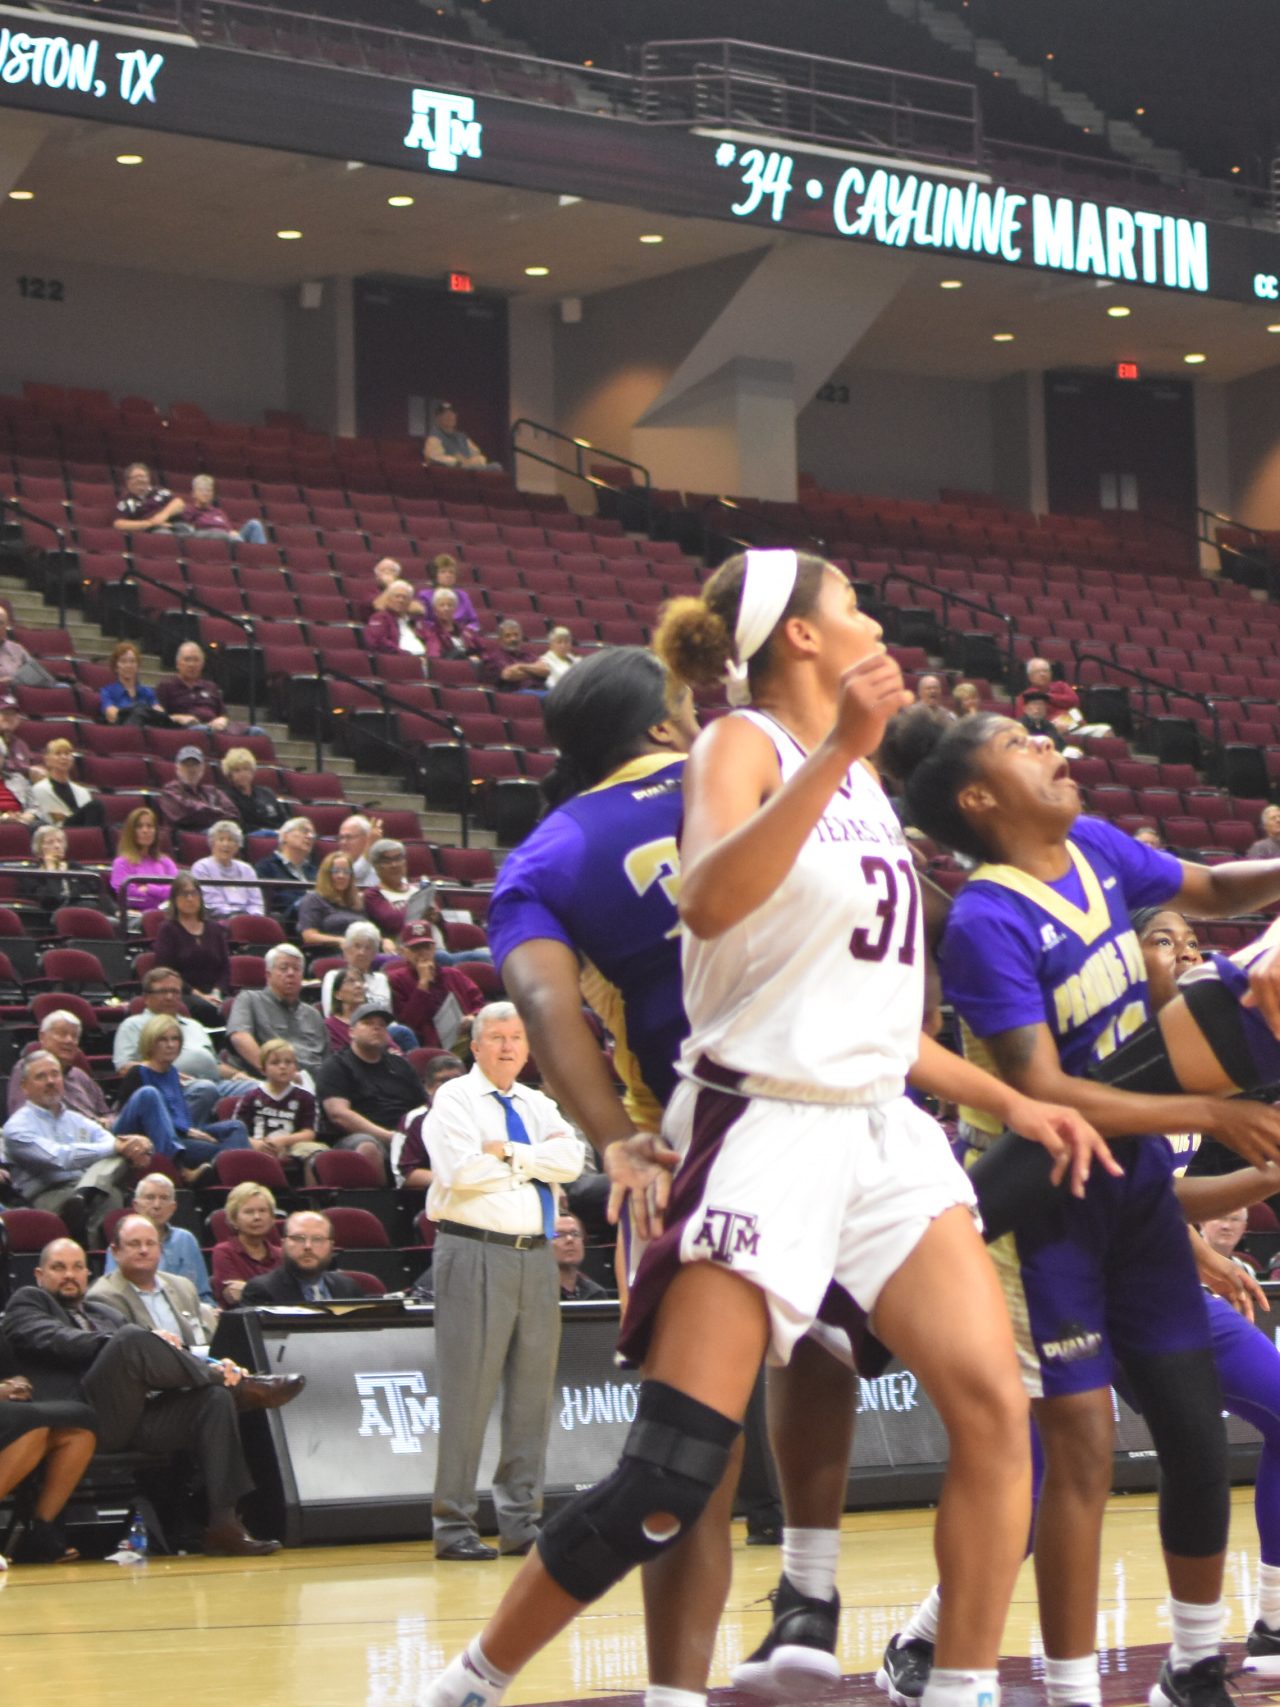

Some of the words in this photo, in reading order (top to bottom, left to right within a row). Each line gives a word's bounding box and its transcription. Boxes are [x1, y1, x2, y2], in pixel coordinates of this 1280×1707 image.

[115, 49, 164, 105] TX
[1032, 193, 1208, 291] MARTIN
[849, 855, 918, 966] 31
[560, 1381, 641, 1430] JUNIO
[855, 1370, 919, 1414] NTER
